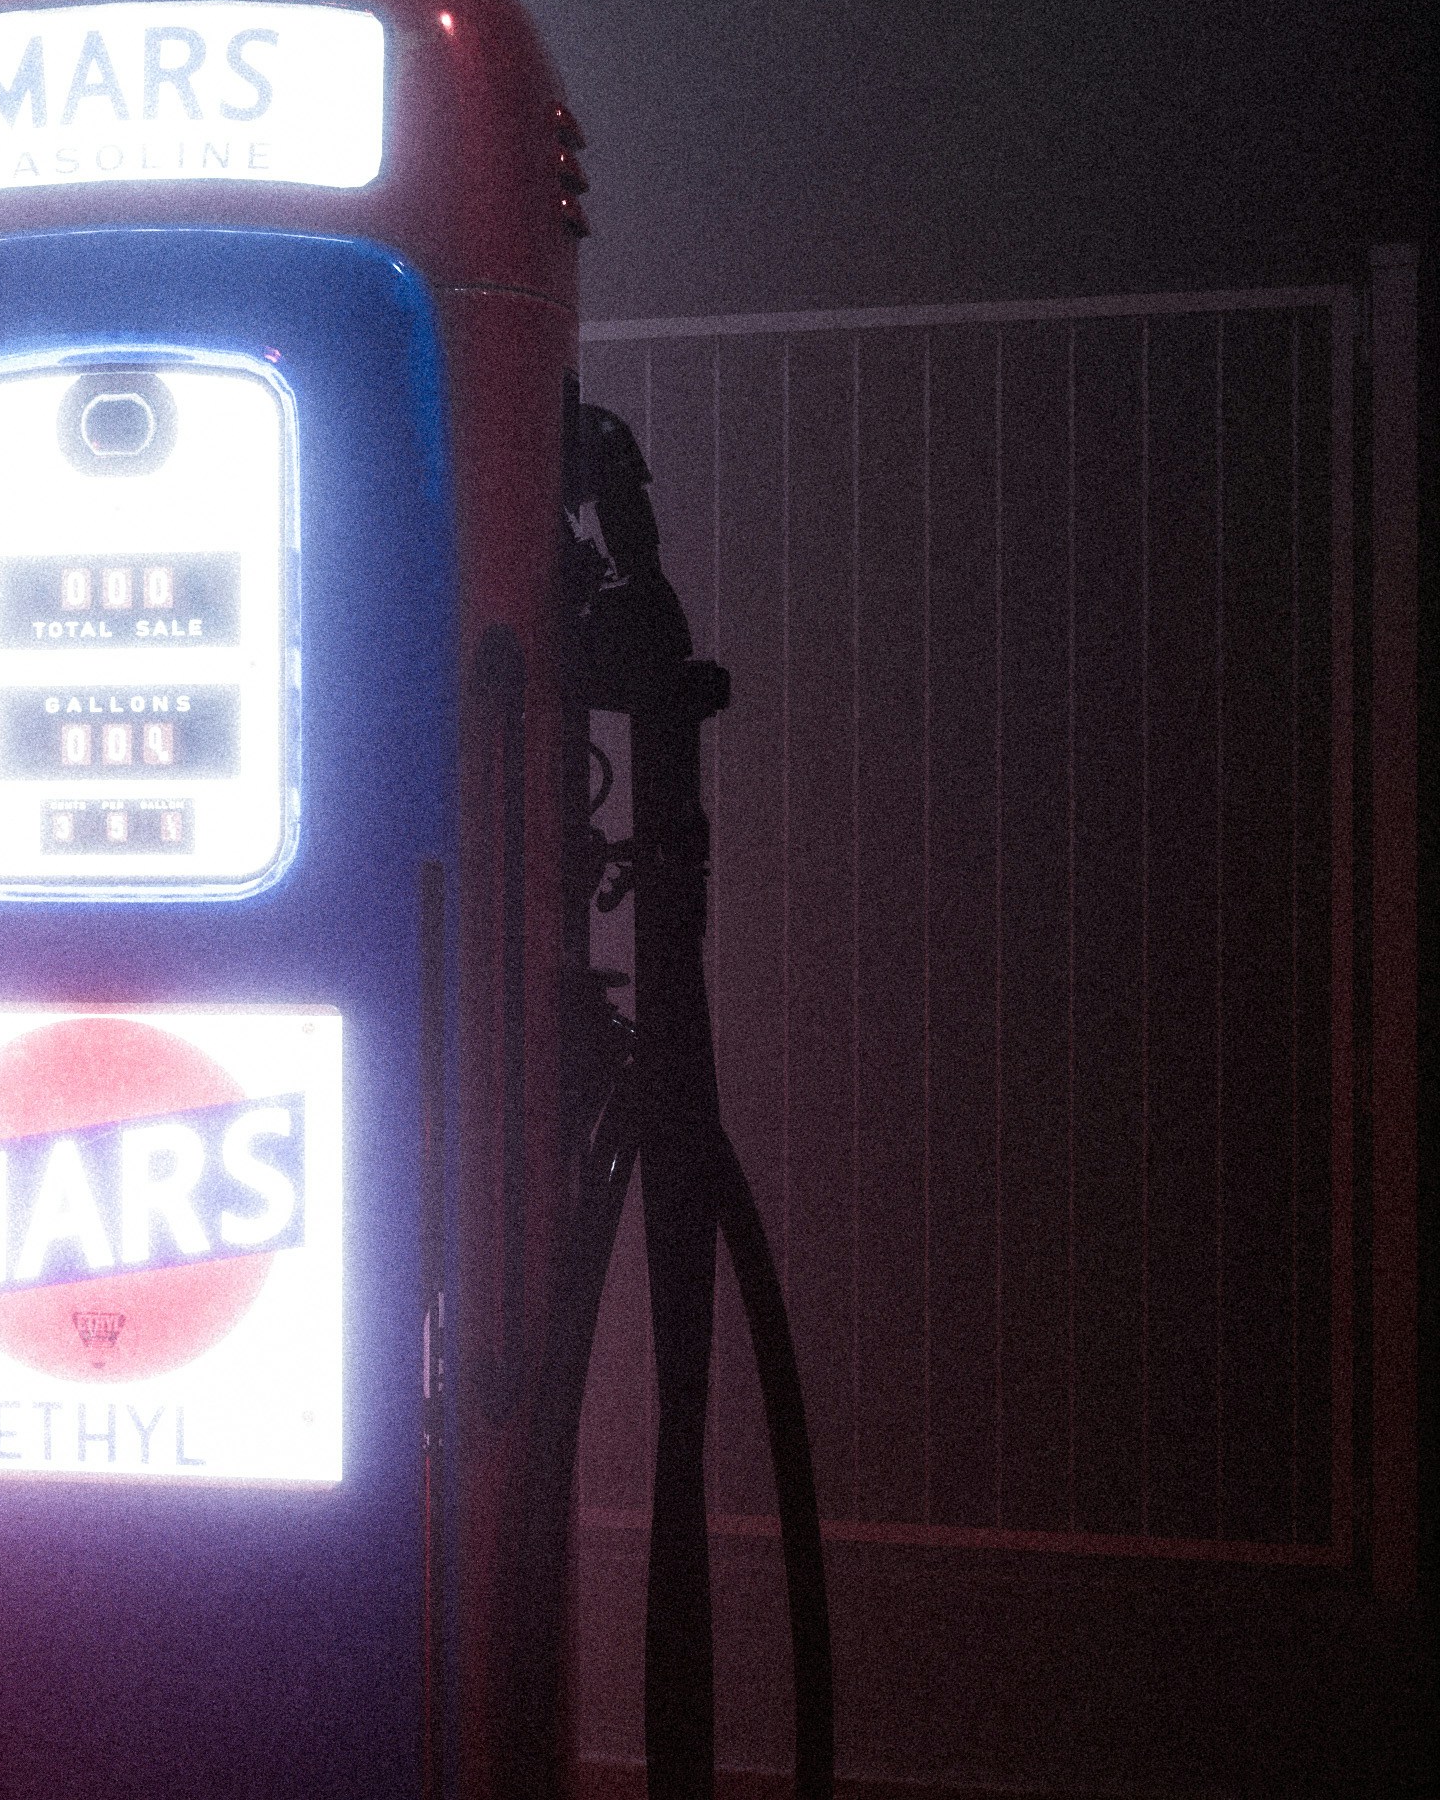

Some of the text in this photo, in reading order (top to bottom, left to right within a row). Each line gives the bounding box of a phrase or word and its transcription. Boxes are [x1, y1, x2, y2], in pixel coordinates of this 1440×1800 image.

[33, 619, 202, 638] TOTAL SALE
[45, 696, 191, 714] GALLONS
